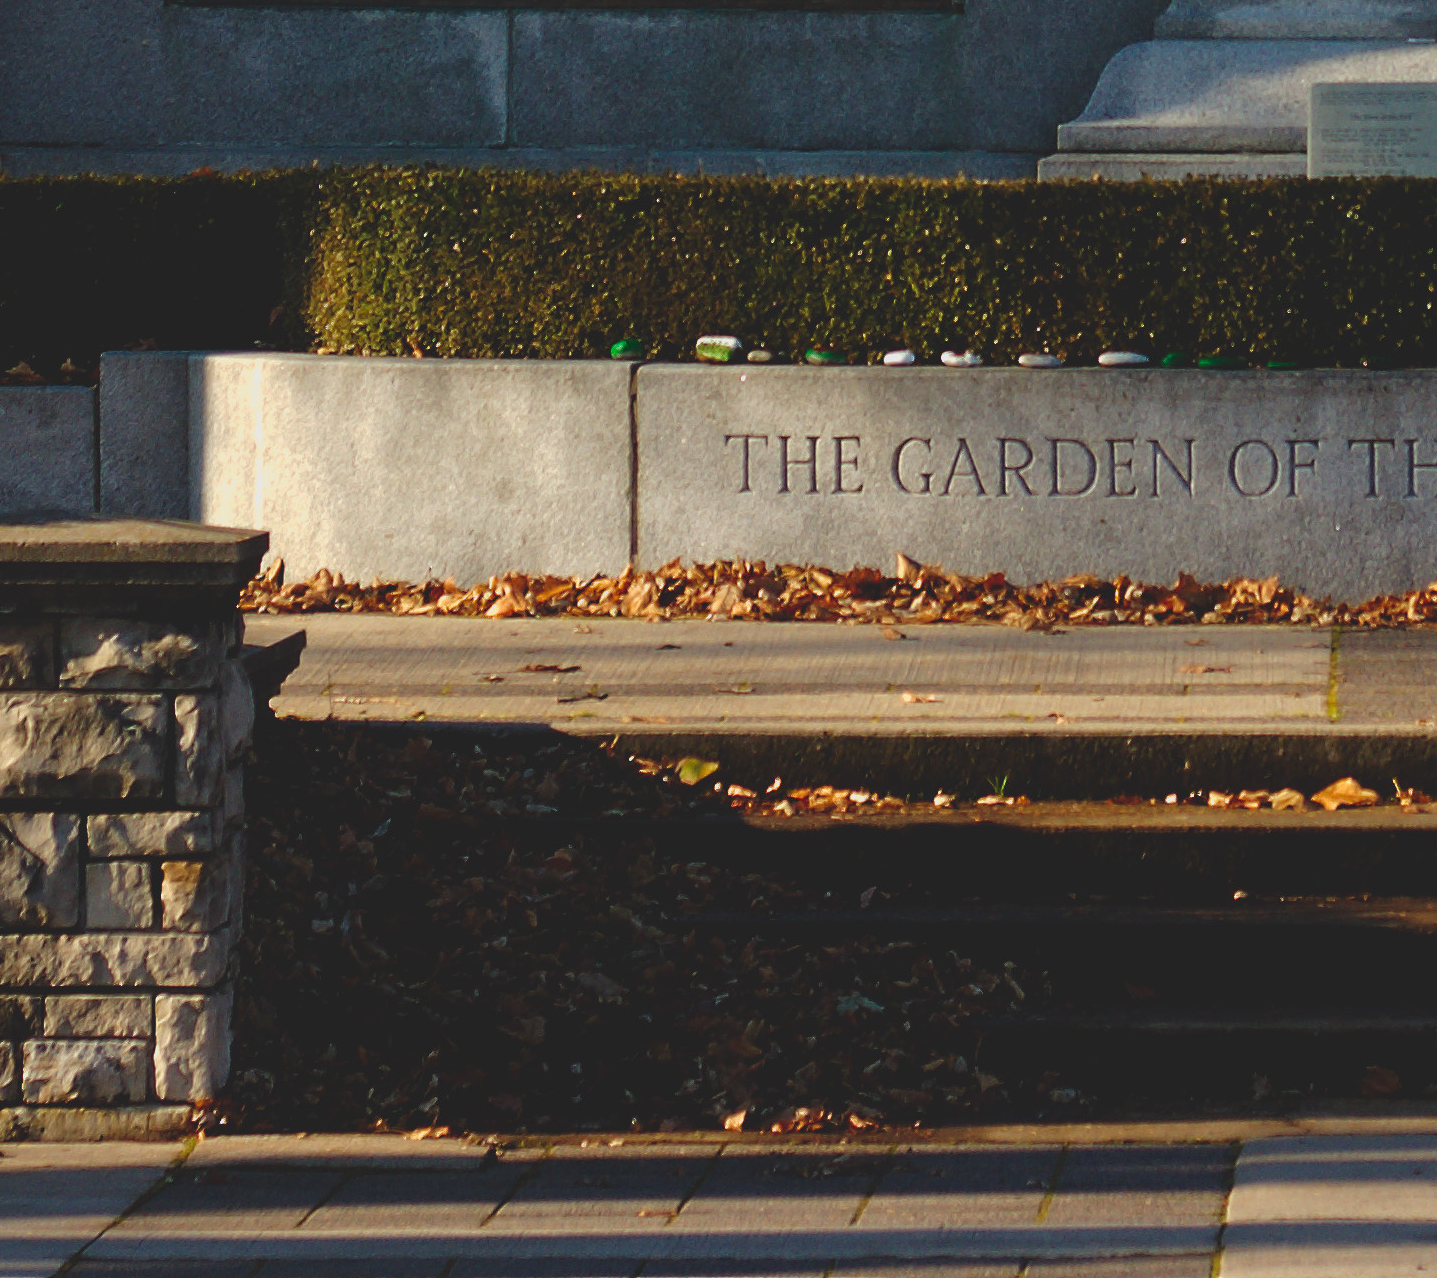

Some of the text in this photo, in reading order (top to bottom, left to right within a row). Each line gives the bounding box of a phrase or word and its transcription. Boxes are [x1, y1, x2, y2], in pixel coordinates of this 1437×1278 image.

[723, 433, 863, 495] THE
[889, 434, 1198, 498] GARDEN
[1227, 435, 1322, 499] OF
